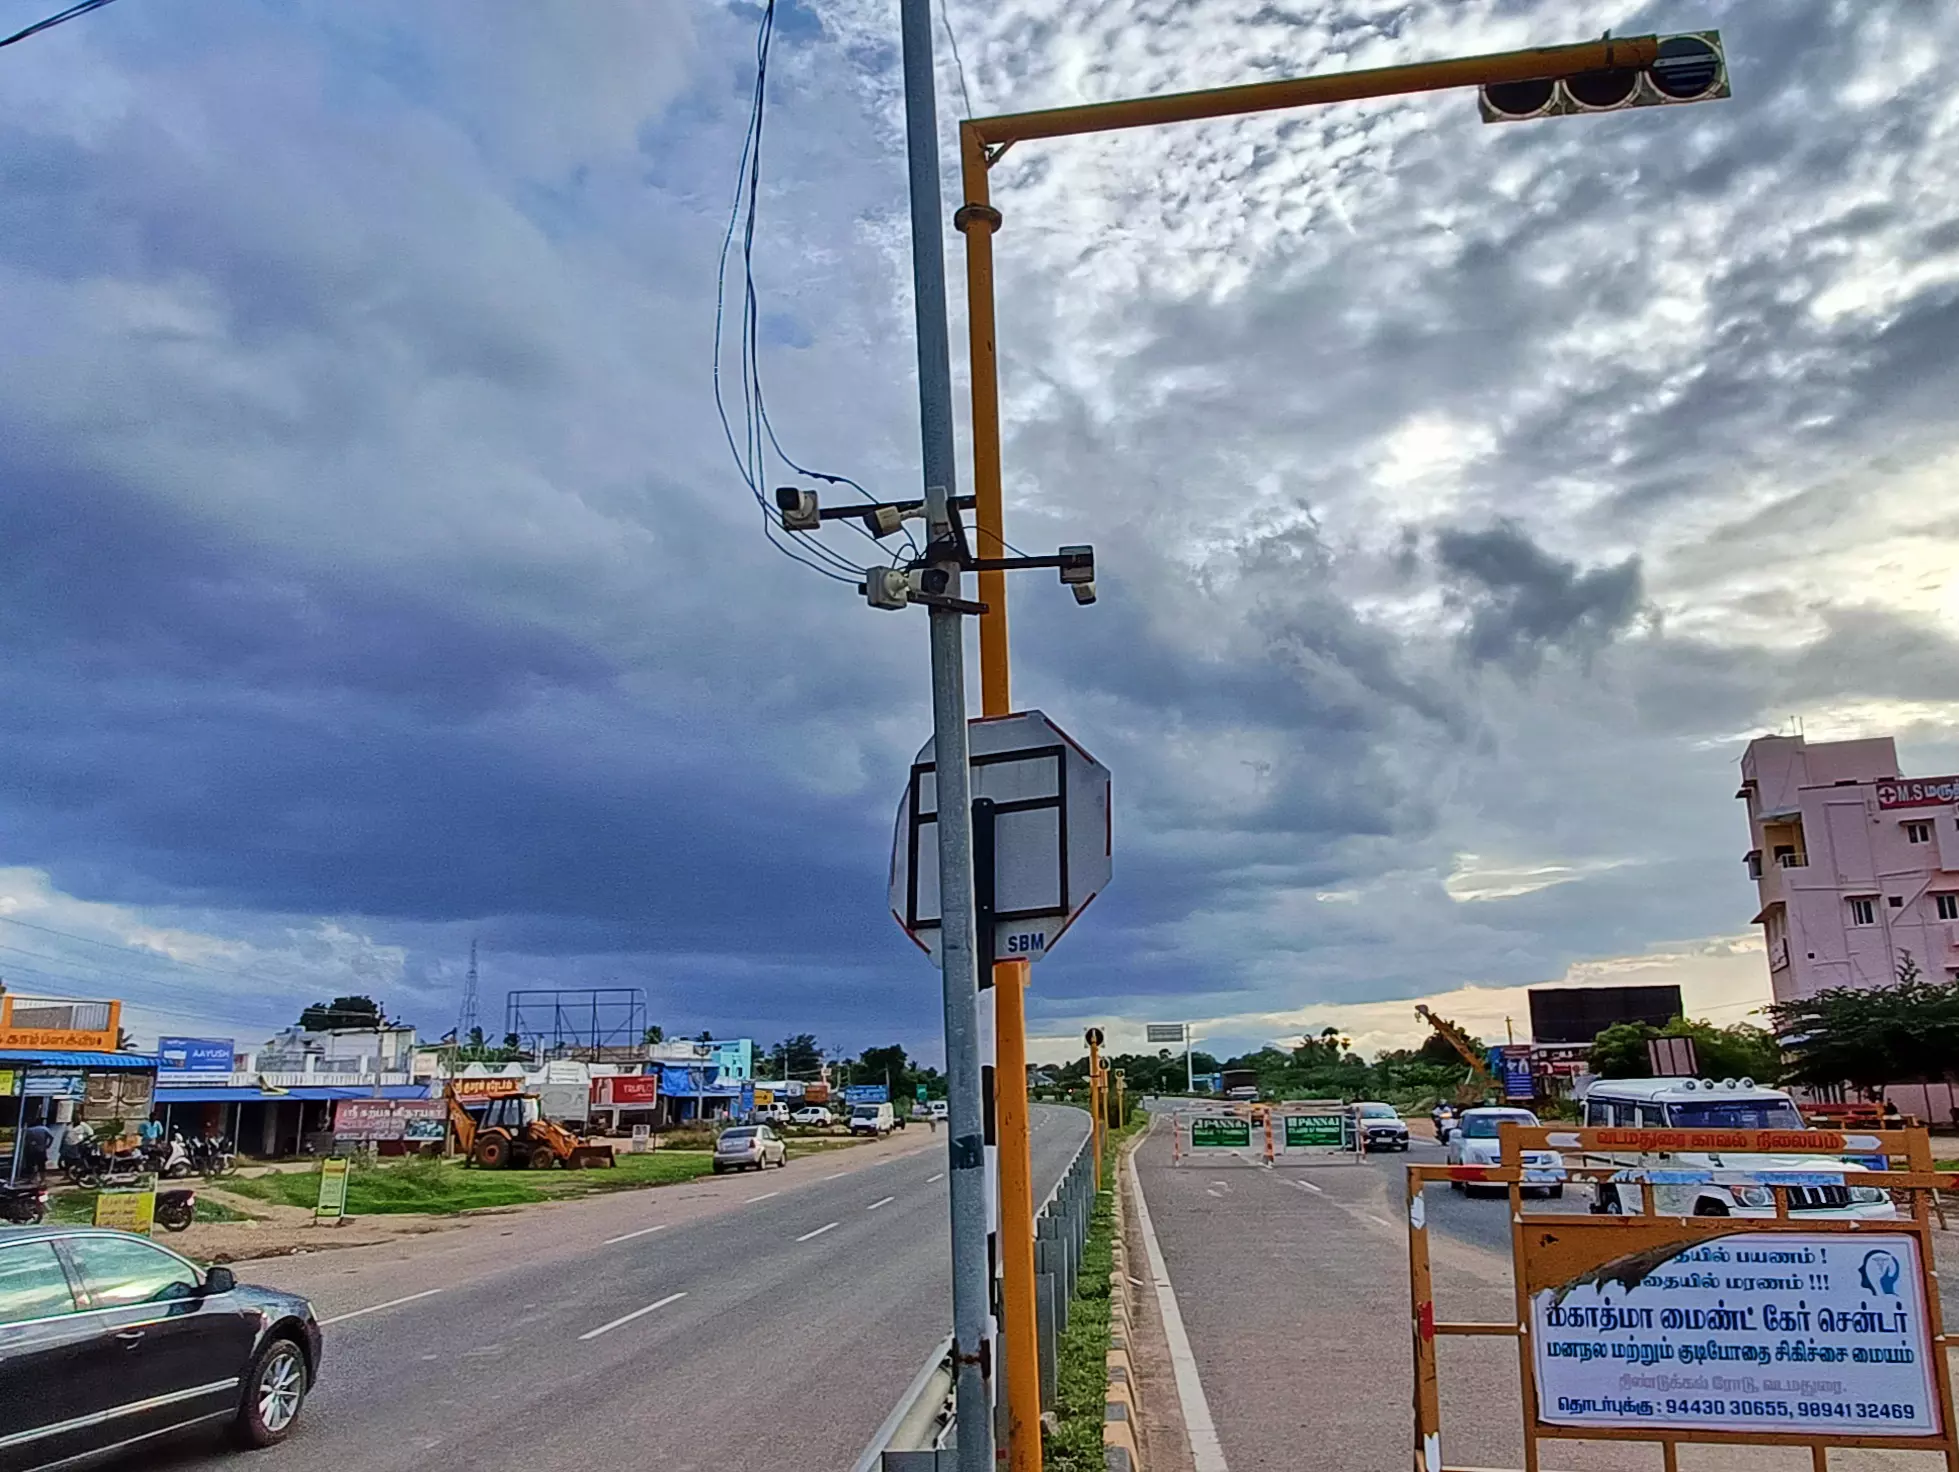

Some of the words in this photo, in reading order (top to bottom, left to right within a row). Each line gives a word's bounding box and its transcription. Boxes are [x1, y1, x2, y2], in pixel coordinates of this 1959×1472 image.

[1897, 784, 1923, 802] M.S
[1008, 932, 1044, 953] SBM
[1298, 1117, 1340, 1127] PANNAI
[1596, 1131, 1686, 1149] வடமதுரை
[1691, 1131, 1748, 1148] காவல்
[1756, 1131, 1840, 1150] நிலையம்
[1736, 1246, 1816, 1264] பயணம்
[1726, 1273, 1804, 1291] மரணம்
[1546, 1297, 1654, 1332] மகாத்மா
[1660, 1299, 1757, 1332] மைண்ட்
[1763, 1300, 1811, 1332] கேர்
[1817, 1301, 1908, 1333] சென்டர்
[1547, 1341, 1608, 1363] மனநல
[1611, 1335, 1674, 1366] மற்றும்
[1678, 1339, 1771, 1366] குடிபோதை
[1774, 1337, 1849, 1364] சிகிச்சை
[1852, 1340, 1915, 1364] மையம்
[1619, 1373, 1708, 1391] திண்டுக்கல்
[1557, 1396, 1654, 1416] தொடர்புக்கு
[1665, 1400, 1725, 1415] 94430
[1730, 1400, 1794, 1419] 30655,
[1797, 1402, 1851, 1417] 98941
[1856, 1402, 1915, 1419] 32469
